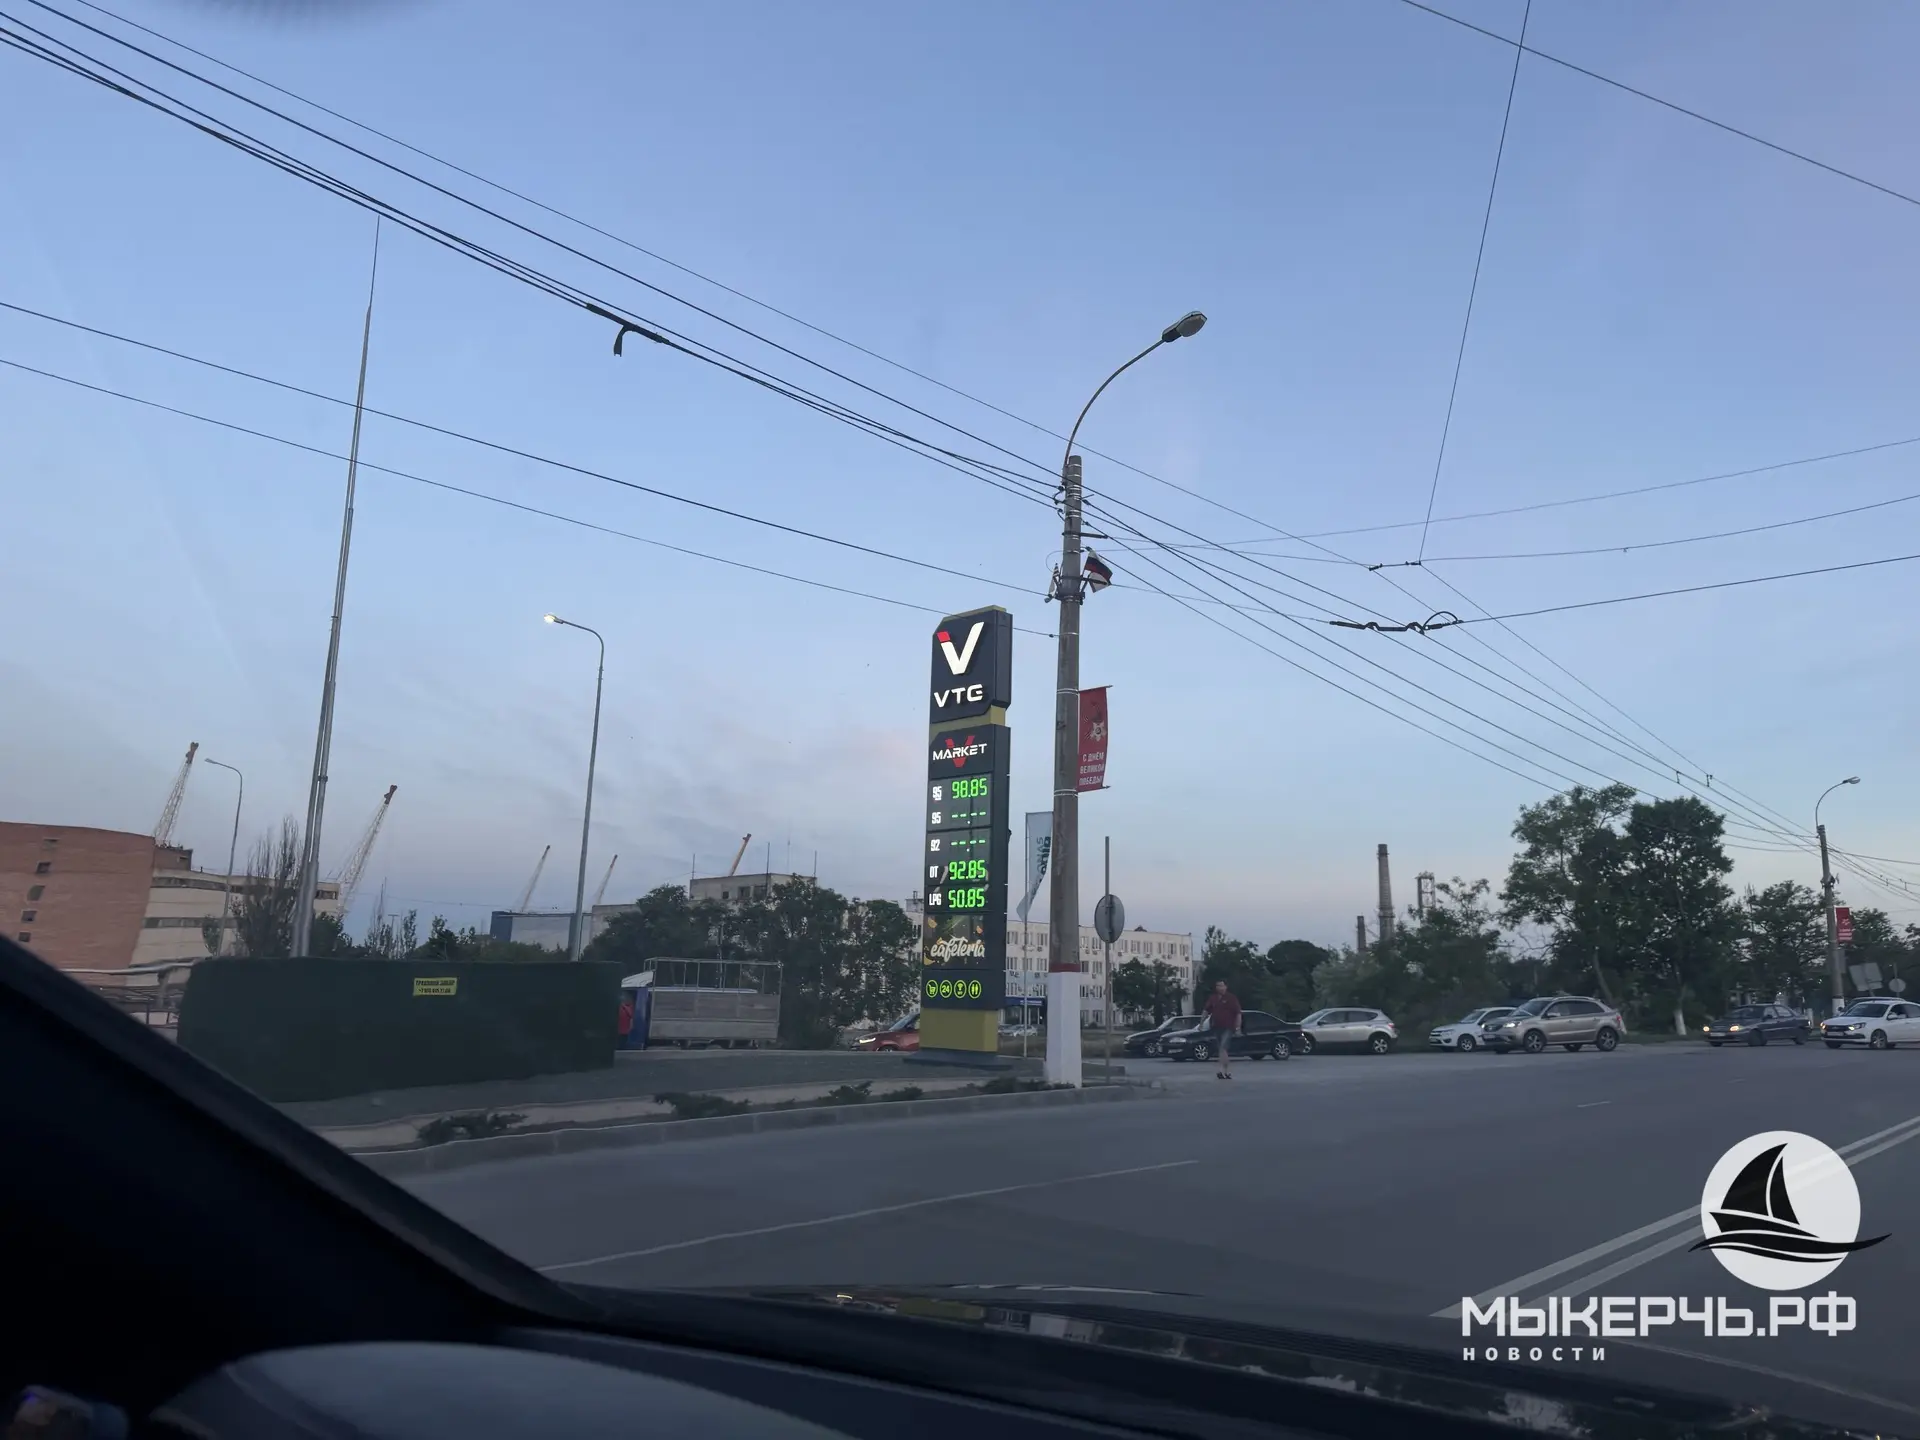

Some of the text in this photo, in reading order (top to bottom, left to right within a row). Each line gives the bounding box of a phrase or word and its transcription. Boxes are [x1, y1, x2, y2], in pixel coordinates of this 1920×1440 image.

[933, 684, 983, 708] VTG
[932, 743, 988, 761] MARKET
[1082, 753, 1087, 762] С
[952, 778, 988, 799] 98.85
[931, 812, 942, 824] 95
[930, 839, 941, 852] 92
[949, 860, 986, 880] 92.85
[928, 888, 985, 908] LPG 50.85
[941, 984, 950, 993] 24
